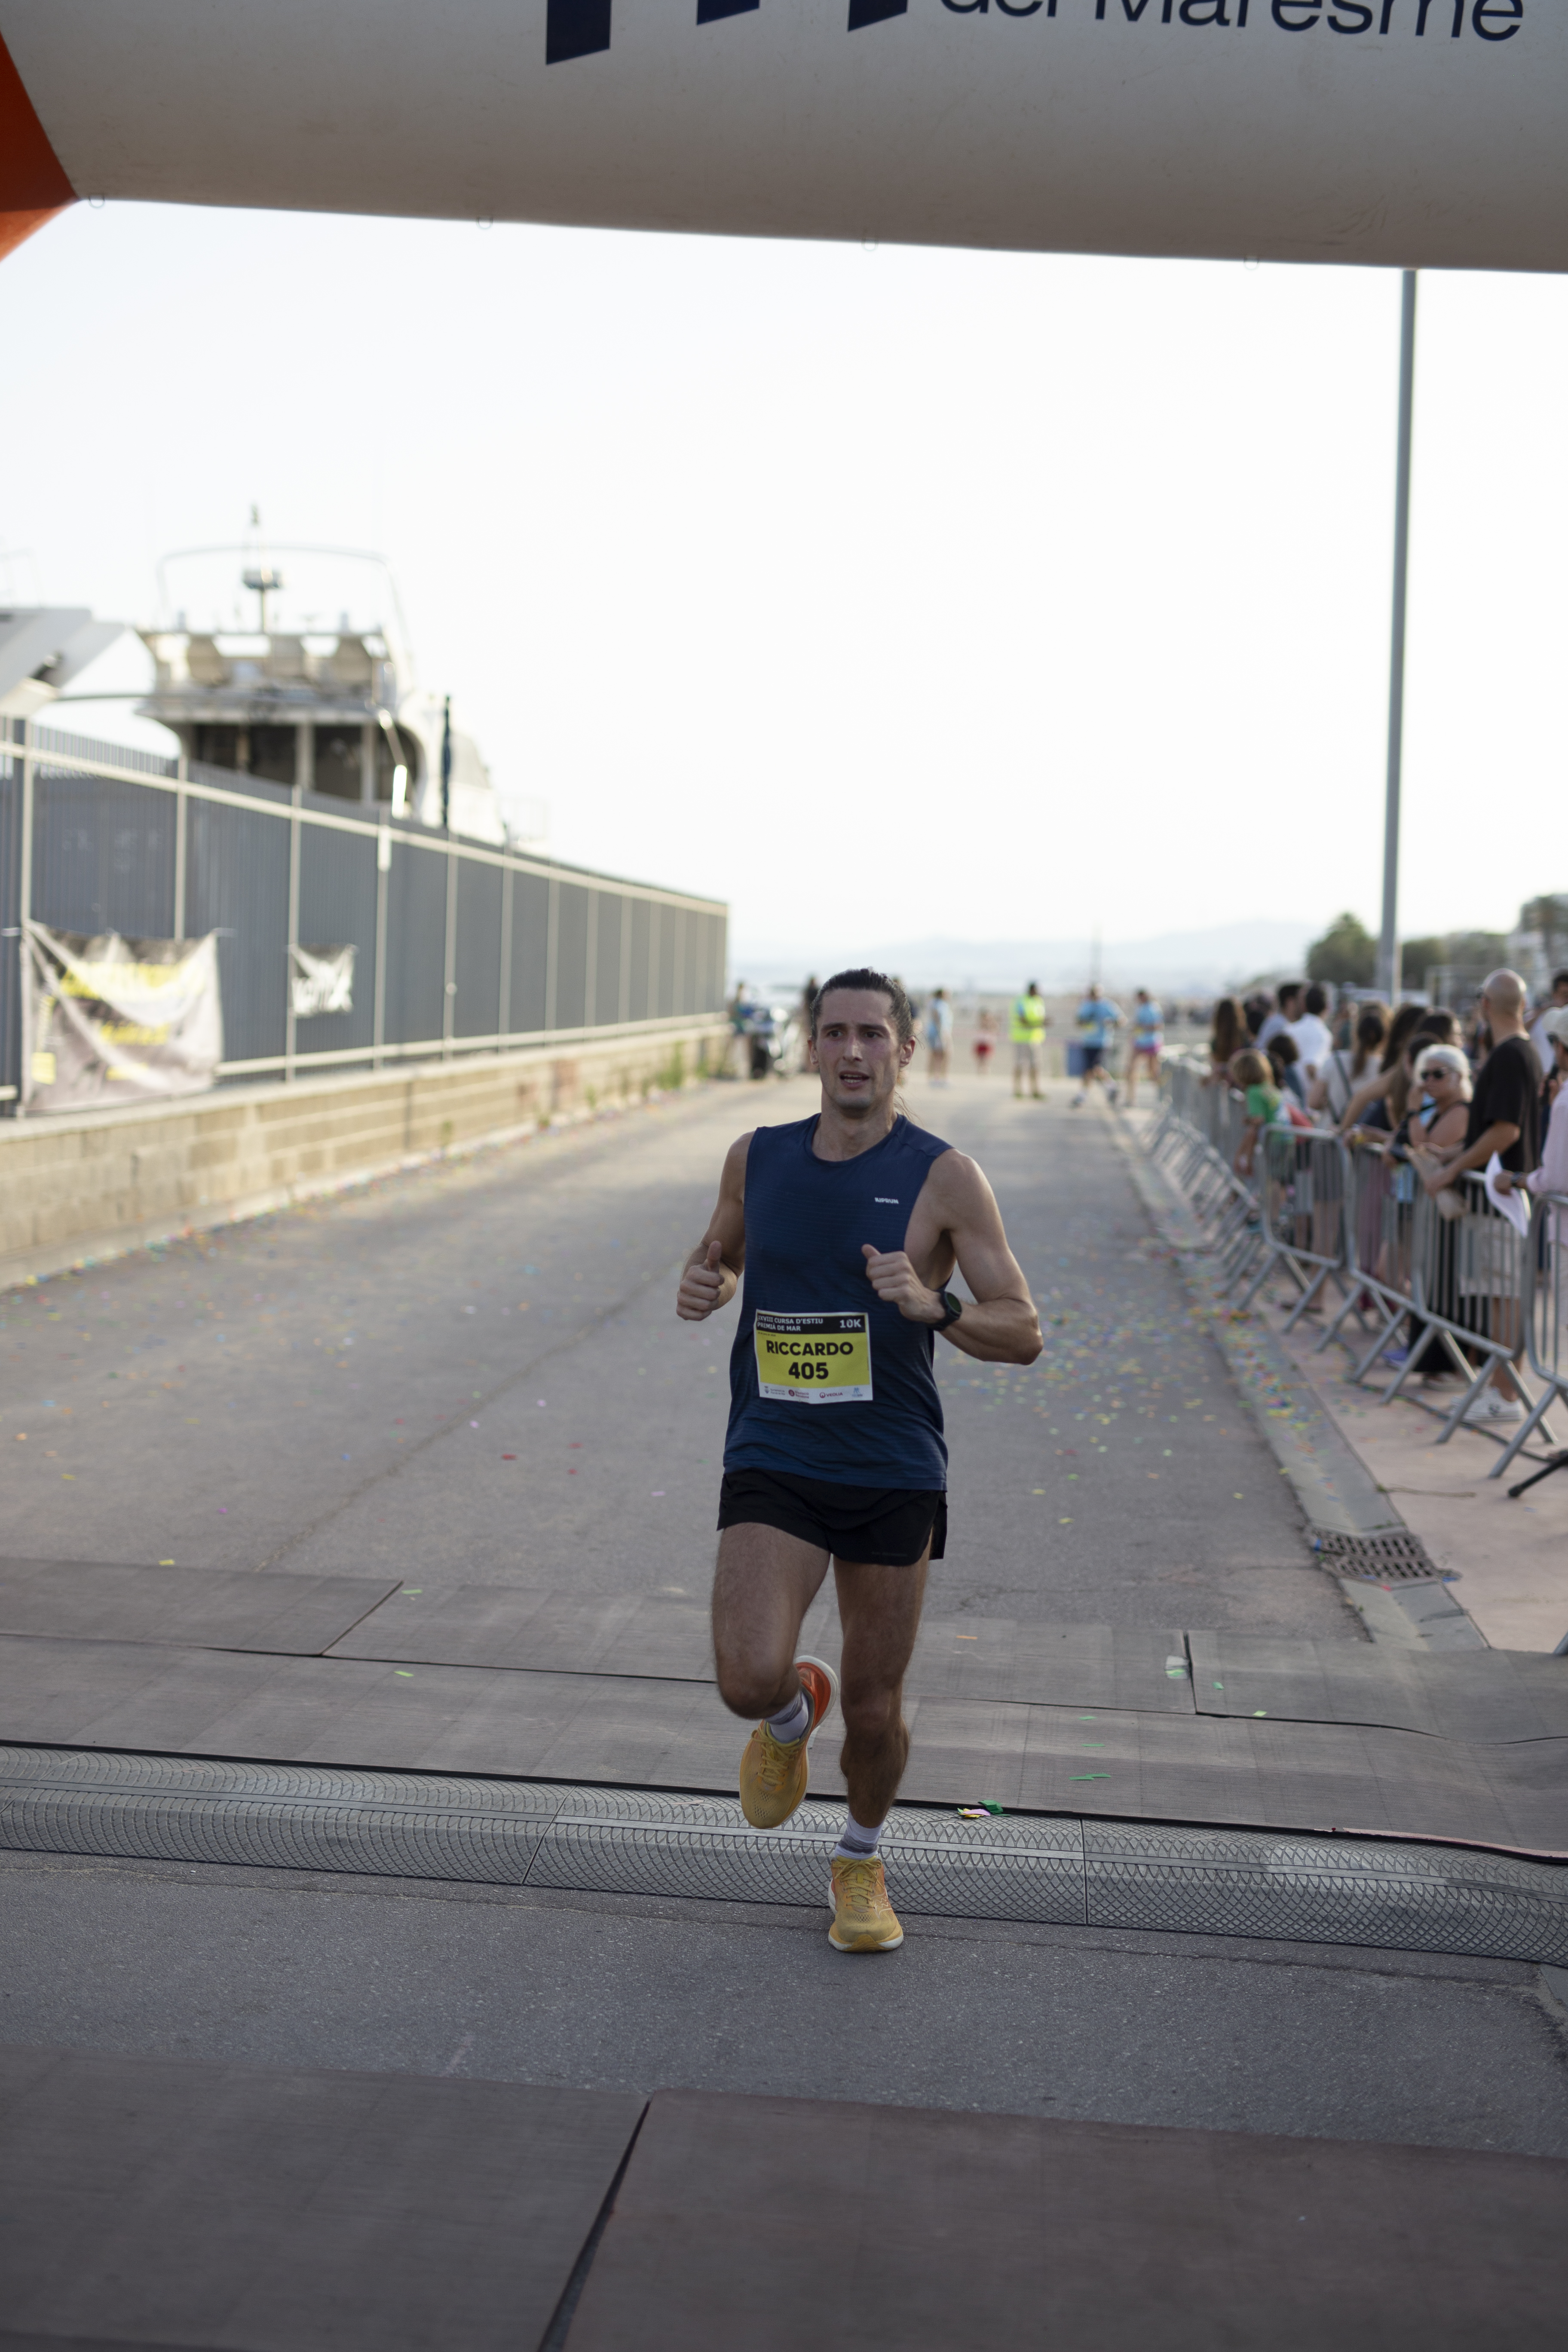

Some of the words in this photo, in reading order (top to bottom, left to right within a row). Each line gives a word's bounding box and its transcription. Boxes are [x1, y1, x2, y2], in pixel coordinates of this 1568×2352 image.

[1094, 0, 1524, 42] aesme
[839, 1319, 861, 1329] 10K
[766, 1340, 853, 1356] RICCARDO
[788, 1362, 829, 1380] 405
